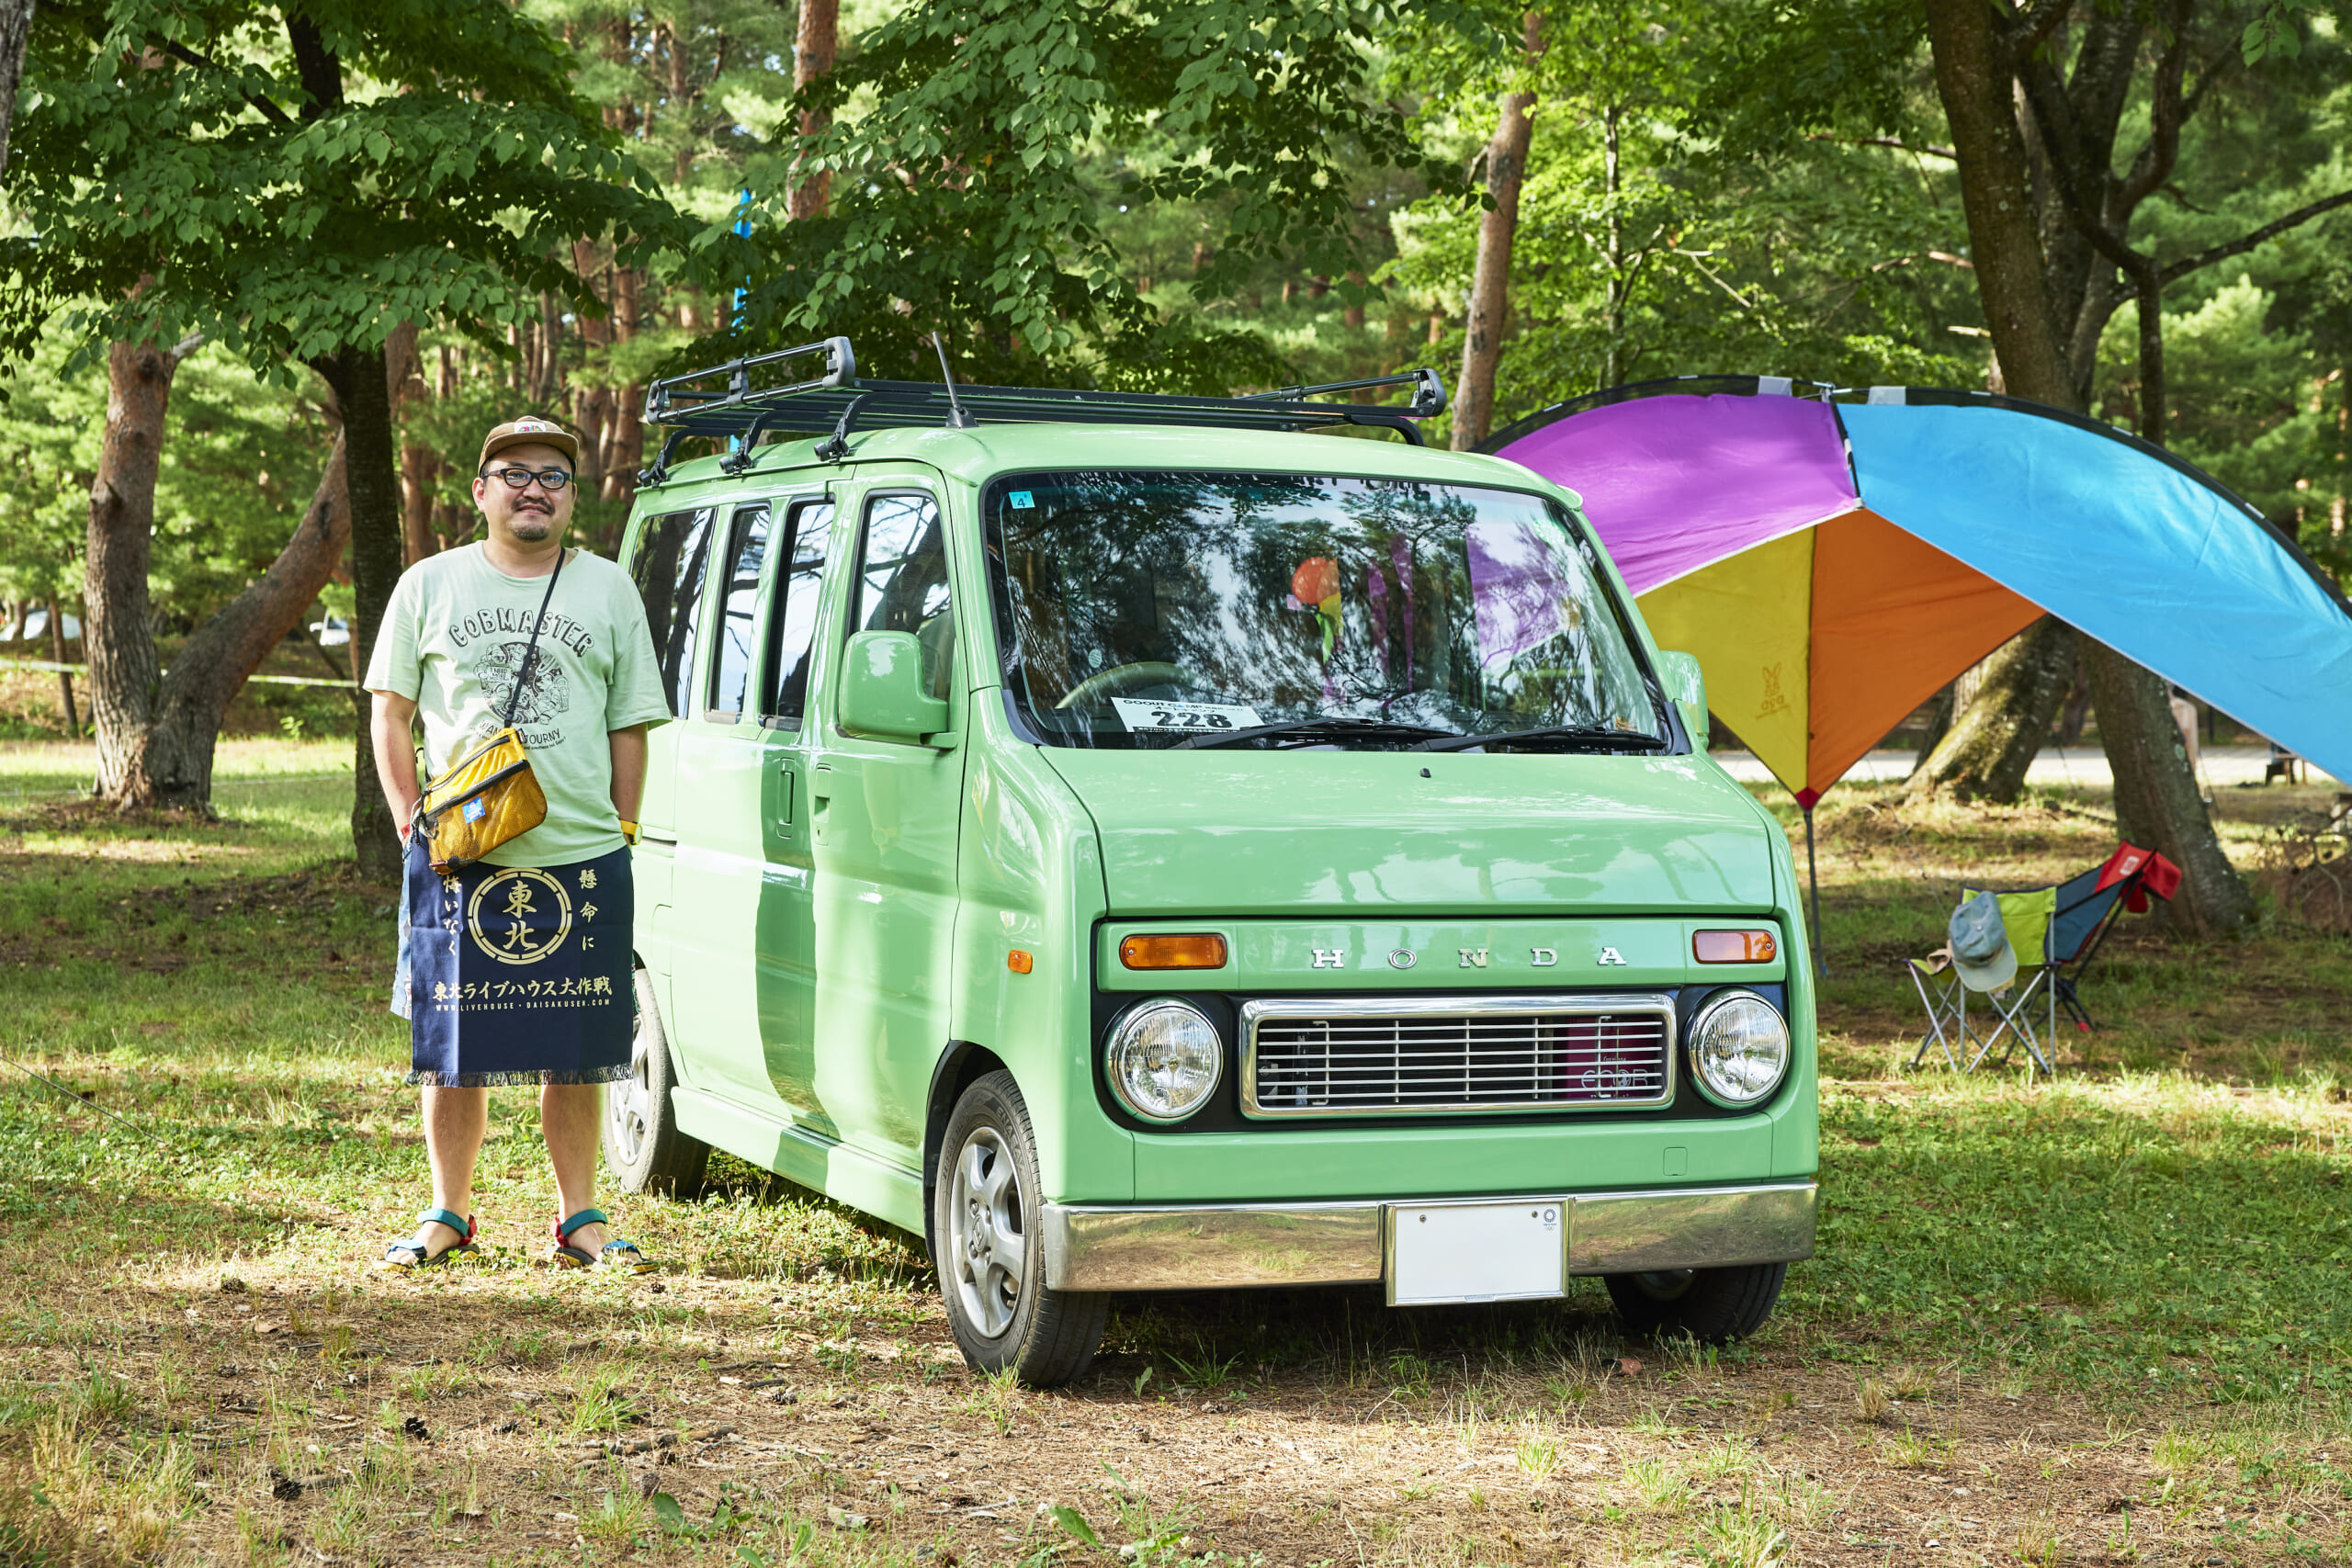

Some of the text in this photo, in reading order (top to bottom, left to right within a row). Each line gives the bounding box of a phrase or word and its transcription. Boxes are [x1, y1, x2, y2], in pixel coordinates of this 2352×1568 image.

[1017, 497, 1026, 507] 4
[448, 607, 594, 658] COBMASTER
[1151, 711, 1233, 728] 228
[443, 874, 462, 956] 悔いなく
[502, 879, 539, 951] 東北
[579, 868, 598, 952] 懸命に
[1312, 947, 1627, 969] HONDA
[432, 976, 613, 1003] 東北ライブハウス大作戦
